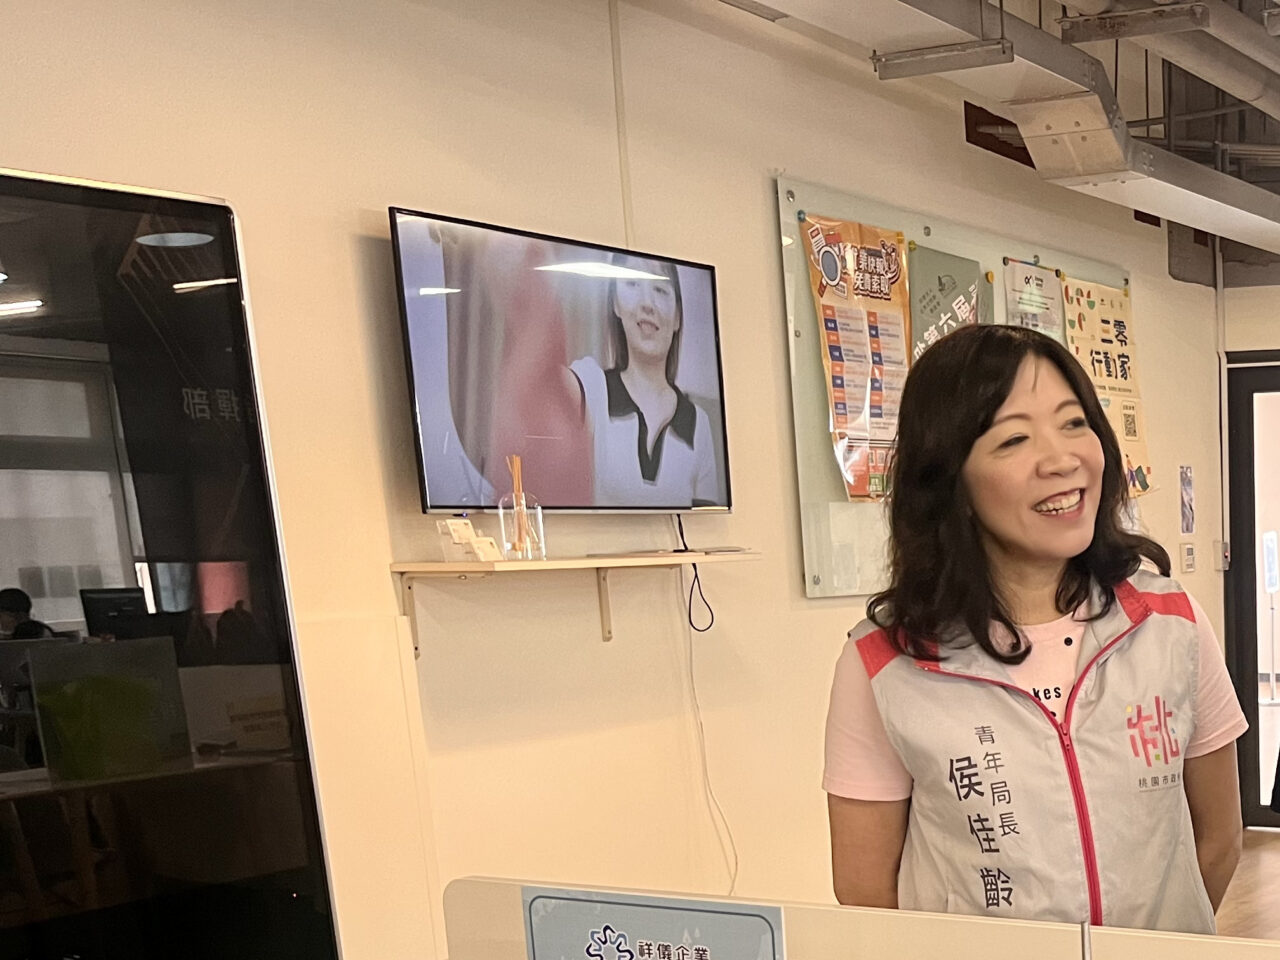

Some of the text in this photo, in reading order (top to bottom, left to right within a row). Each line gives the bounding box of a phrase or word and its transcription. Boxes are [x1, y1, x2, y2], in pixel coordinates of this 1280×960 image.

[949, 755, 1013, 909] 侯佳齡
[974, 725, 1020, 838] 青年局長
